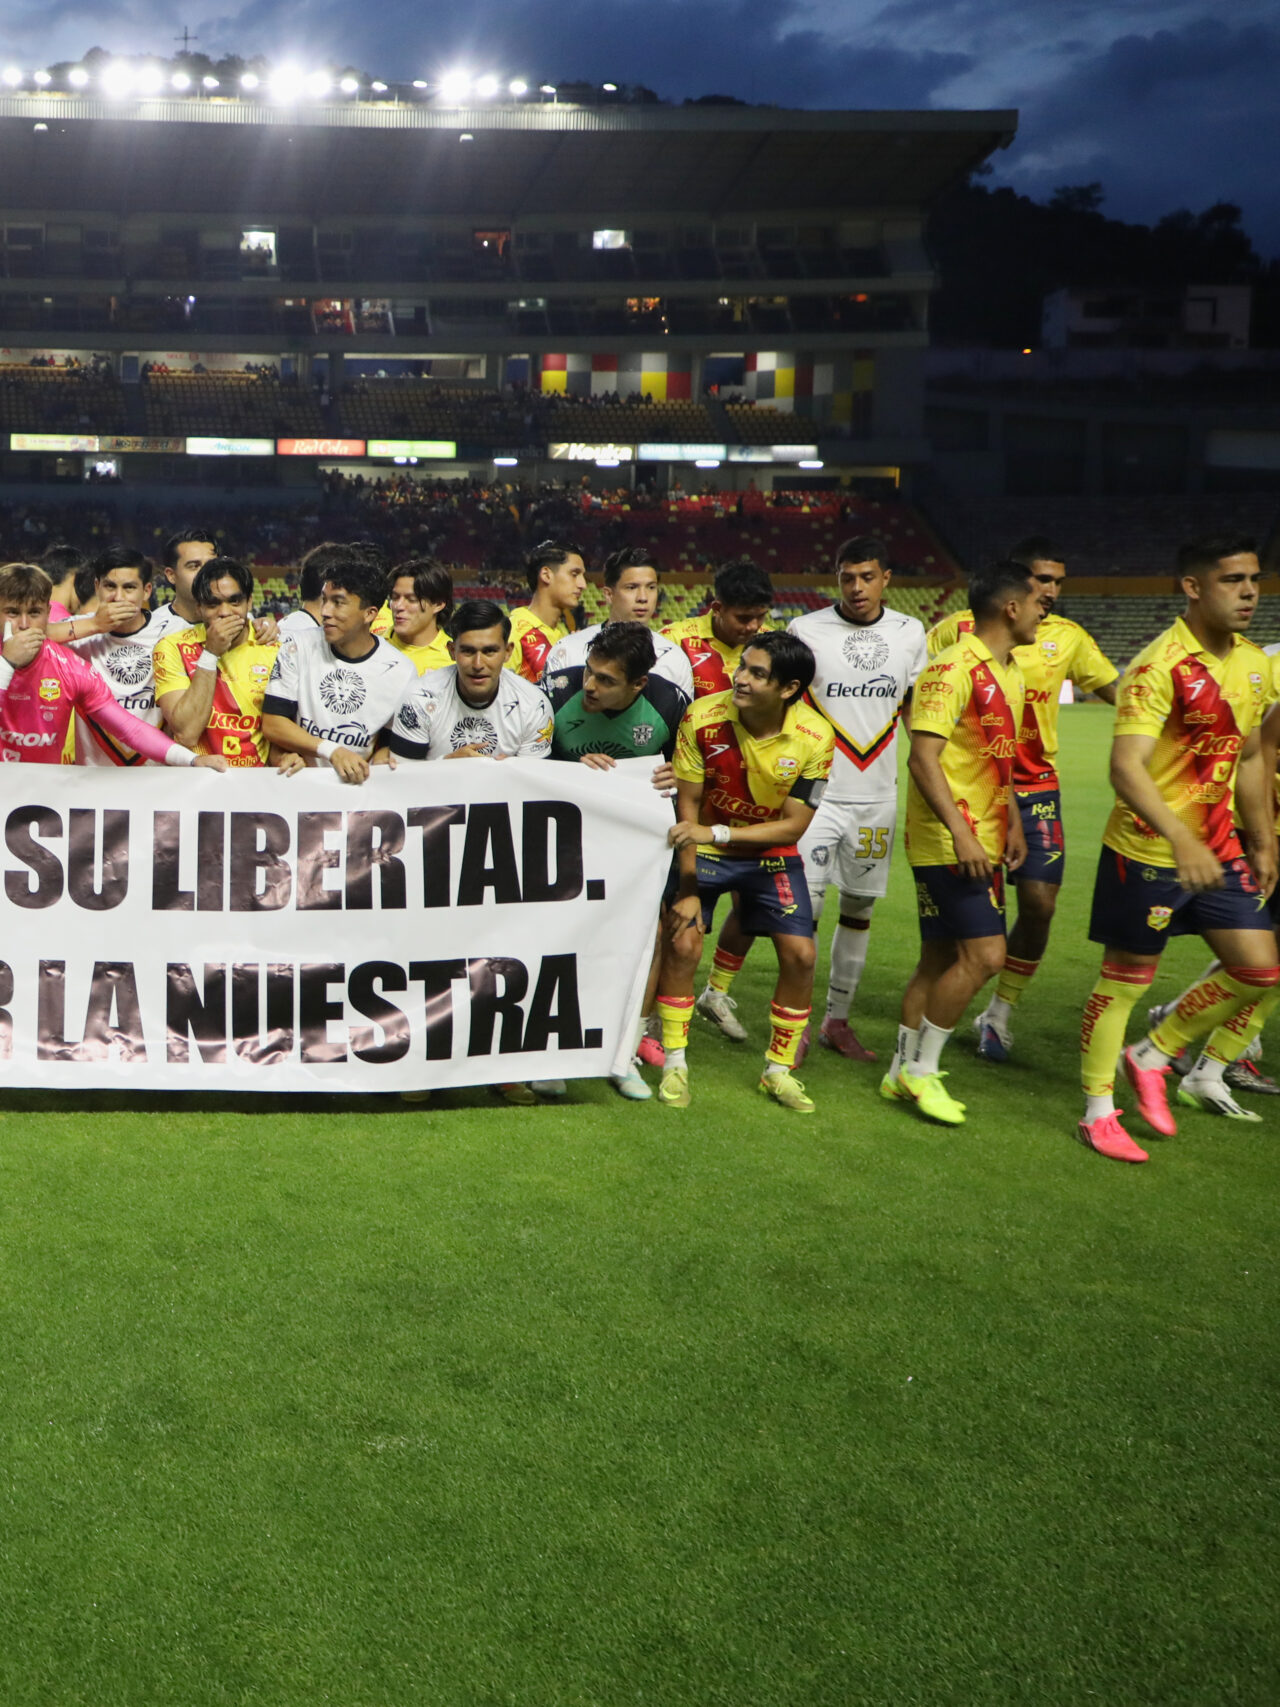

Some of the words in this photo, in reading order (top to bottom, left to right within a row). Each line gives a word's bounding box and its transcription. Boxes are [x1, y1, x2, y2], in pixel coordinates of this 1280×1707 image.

[826, 682, 898, 699] Electrolit
[300, 717, 371, 748] Electrolit
[4, 804, 130, 911] SU
[151, 800, 606, 912] LIBERTAD.
[855, 827, 889, 859] 35
[36, 959, 149, 1063] LA
[166, 952, 603, 1066] NUESTRA.
